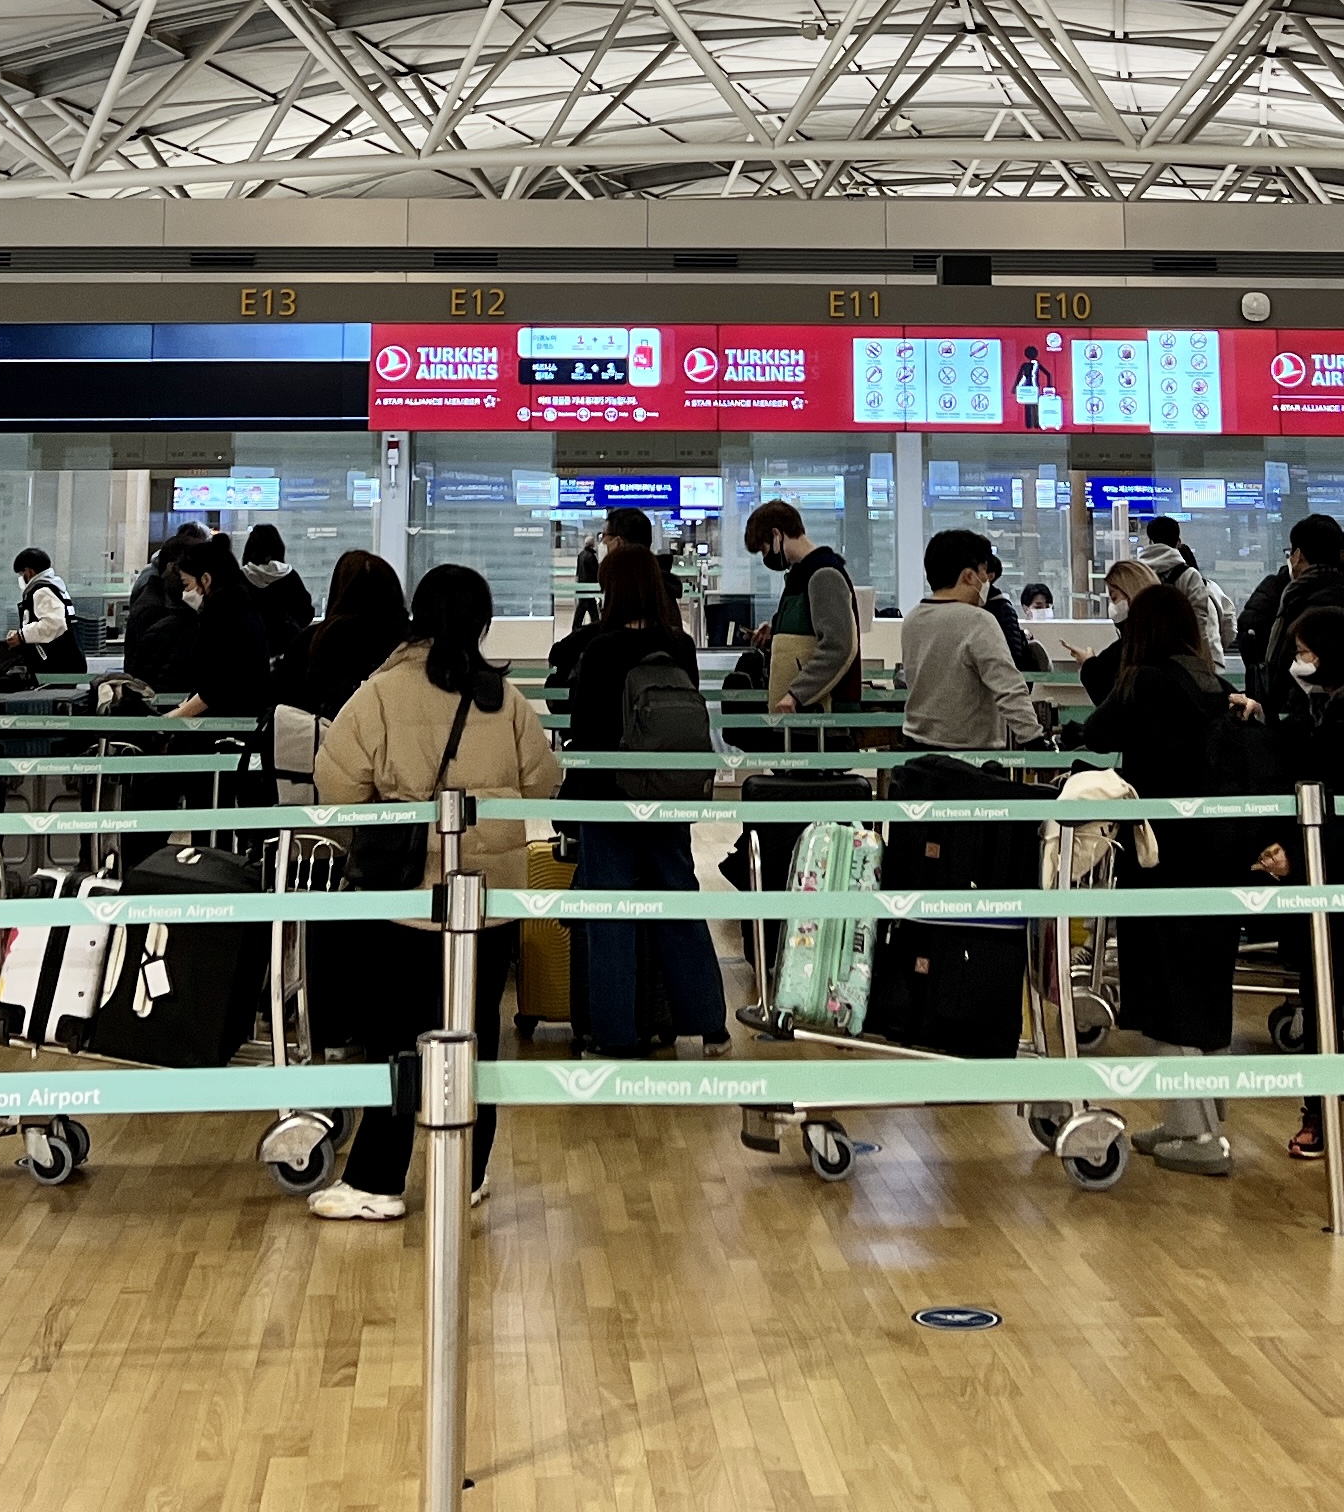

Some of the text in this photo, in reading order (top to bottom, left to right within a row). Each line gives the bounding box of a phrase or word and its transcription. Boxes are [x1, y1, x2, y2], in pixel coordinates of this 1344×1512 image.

[240, 288, 297, 316] E13
[450, 288, 505, 316] E12
[829, 290, 880, 318] E11
[1035, 292, 1091, 320] E10
[416, 347, 498, 363] TURKISH
[724, 349, 805, 365] TURKISH
[415, 364, 499, 380] AIRLINES
[723, 365, 805, 382] AIRLINES
[337, 810, 417, 822] Incheon Airport
[659, 808, 737, 819] Incheon Airport
[931, 807, 1009, 819] Incheon Airport
[57, 818, 137, 830] Incheon Airport
[560, 899, 663, 915] Incheon Airport
[920, 899, 1022, 915] Incheon Airport
[1277, 894, 1327, 909] Incheon
[128, 903, 234, 919] Incheon Airport
[615, 1075, 768, 1099] Incheon Airport
[1155, 1070, 1305, 1093] Incheon Airport
[28, 1087, 100, 1110] Airport
